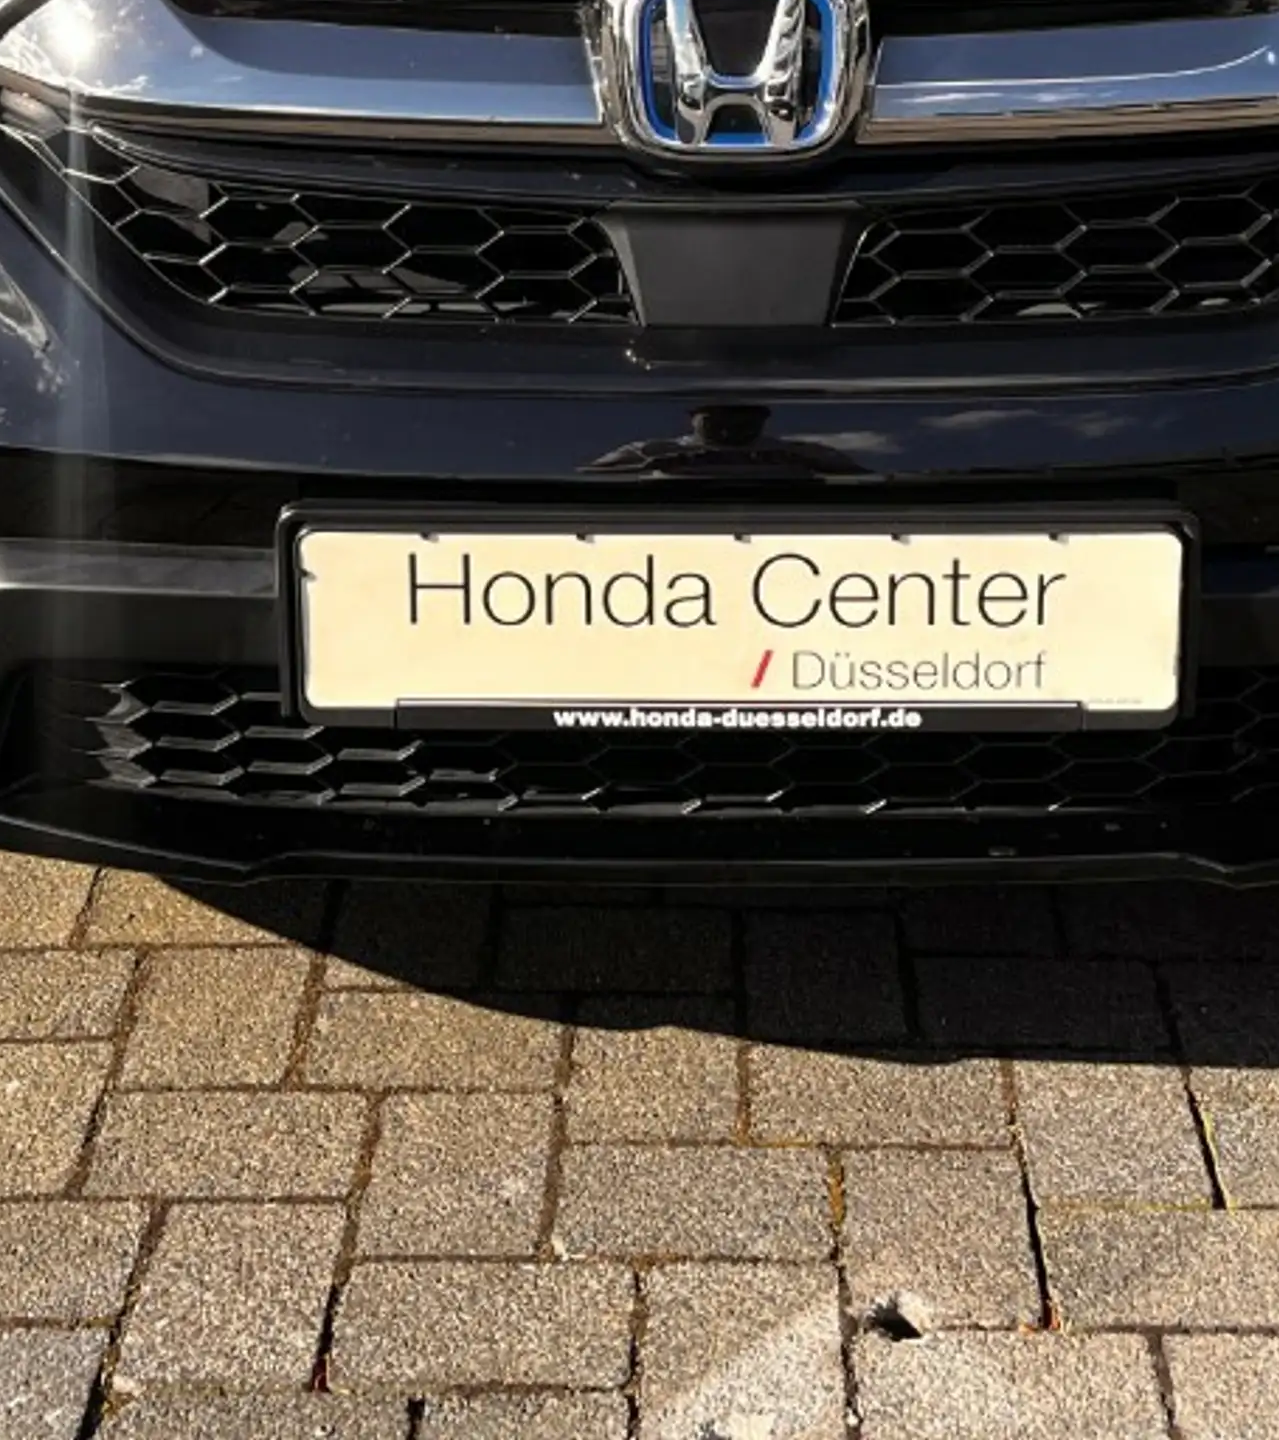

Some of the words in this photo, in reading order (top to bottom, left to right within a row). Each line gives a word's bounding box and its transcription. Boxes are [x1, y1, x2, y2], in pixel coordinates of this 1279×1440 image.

[408, 552, 718, 627] Honda
[752, 552, 1068, 629] Center
[791, 649, 1048, 691] Düsseldorf
[552, 708, 923, 729] www.honda-duesseldorf.de
